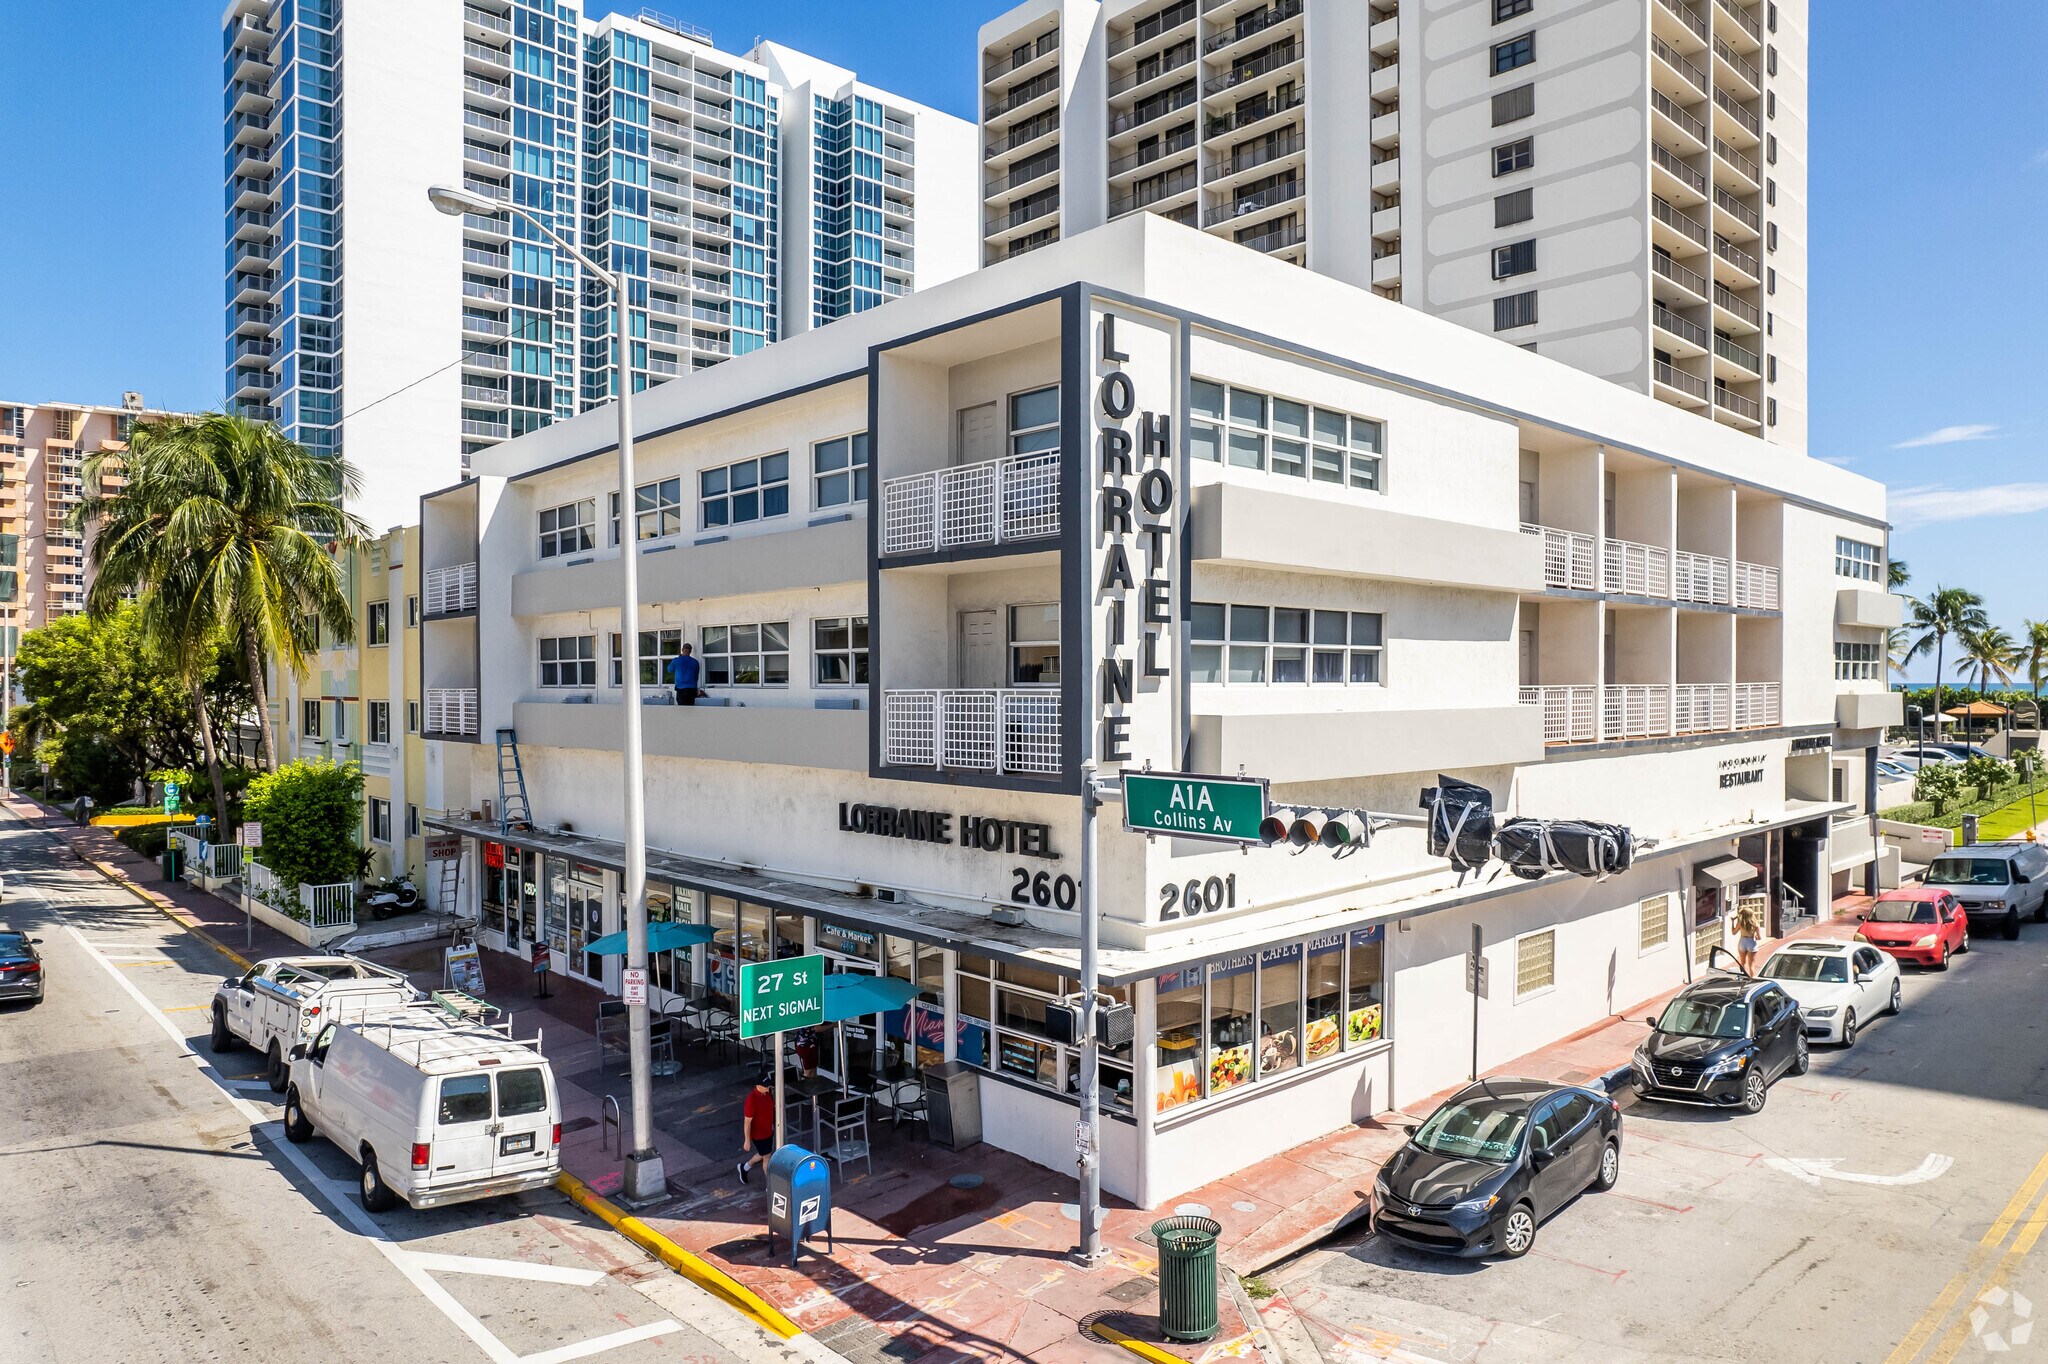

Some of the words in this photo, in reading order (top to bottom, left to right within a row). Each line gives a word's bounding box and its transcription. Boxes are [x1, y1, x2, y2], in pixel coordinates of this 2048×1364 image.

[1101, 313, 1135, 762] LORRAINE
[1140, 411, 1173, 677] HOTEL
[1719, 769, 1764, 789] RESTAURANT
[1169, 783, 1214, 812] A1A
[838, 802, 953, 844] LORRAINE
[959, 814, 1062, 860] HOTEL
[1154, 809, 1206, 830] Collins
[1213, 815, 1232, 832] Av
[432, 848, 457, 858] SHOP
[1011, 867, 1081, 911] 260
[1159, 873, 1236, 922] 2601
[826, 926, 841, 936] Cafe
[841, 930, 847, 938] &
[848, 931, 872, 945] Market
[1261, 943, 1290, 962] CAFE
[1291, 946, 1298, 955] &
[1307, 933, 1344, 951] MARKET
[758, 973, 784, 994] 27
[793, 971, 808, 986] St
[743, 1005, 773, 1023] NEXT
[778, 997, 821, 1017] SIGNAL
